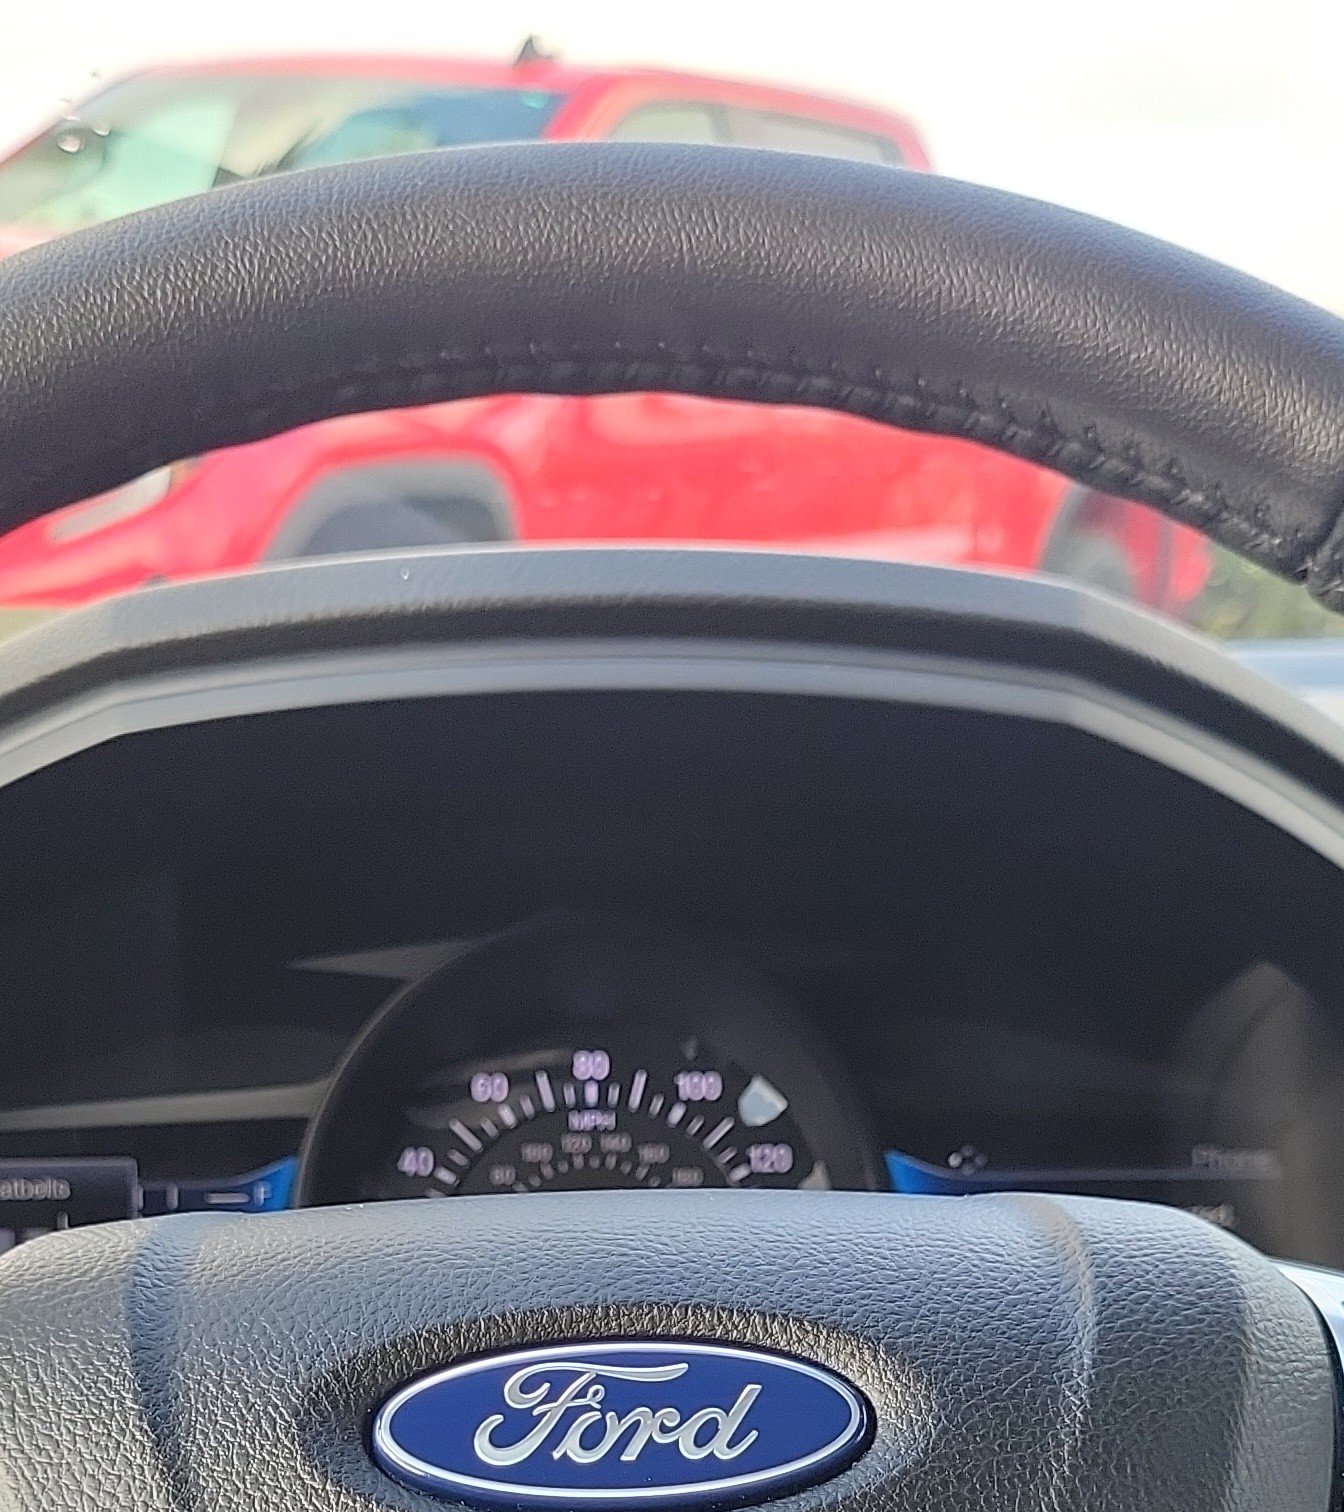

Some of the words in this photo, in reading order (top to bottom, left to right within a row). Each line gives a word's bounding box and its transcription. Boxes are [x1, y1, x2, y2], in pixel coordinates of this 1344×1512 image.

[573, 1049, 610, 1080] 80
[471, 1072, 509, 1102] 60
[674, 1071, 722, 1100] 100
[397, 1146, 434, 1176] 40
[747, 1143, 793, 1173] 120
[474, 1361, 762, 1466] Ford
